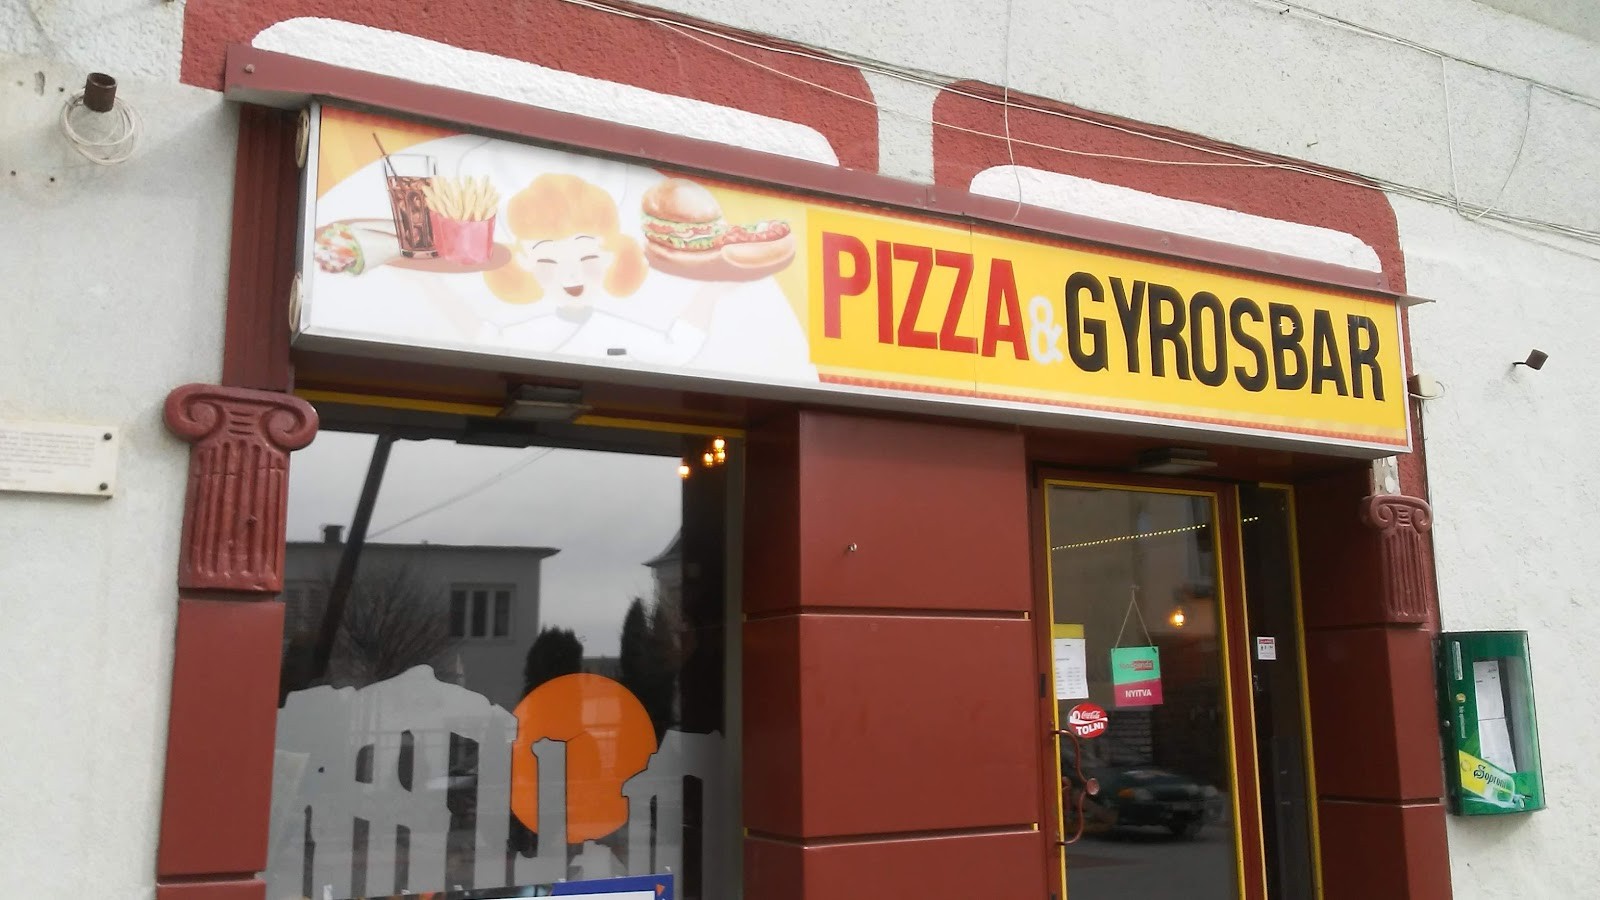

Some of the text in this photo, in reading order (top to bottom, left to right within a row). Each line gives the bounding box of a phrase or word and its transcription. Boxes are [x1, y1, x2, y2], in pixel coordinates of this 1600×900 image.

[822, 231, 1385, 402] PIZZA & GYROSBAR
[1125, 689, 1152, 698] NYITVA
[1076, 722, 1104, 735] TOLNI
